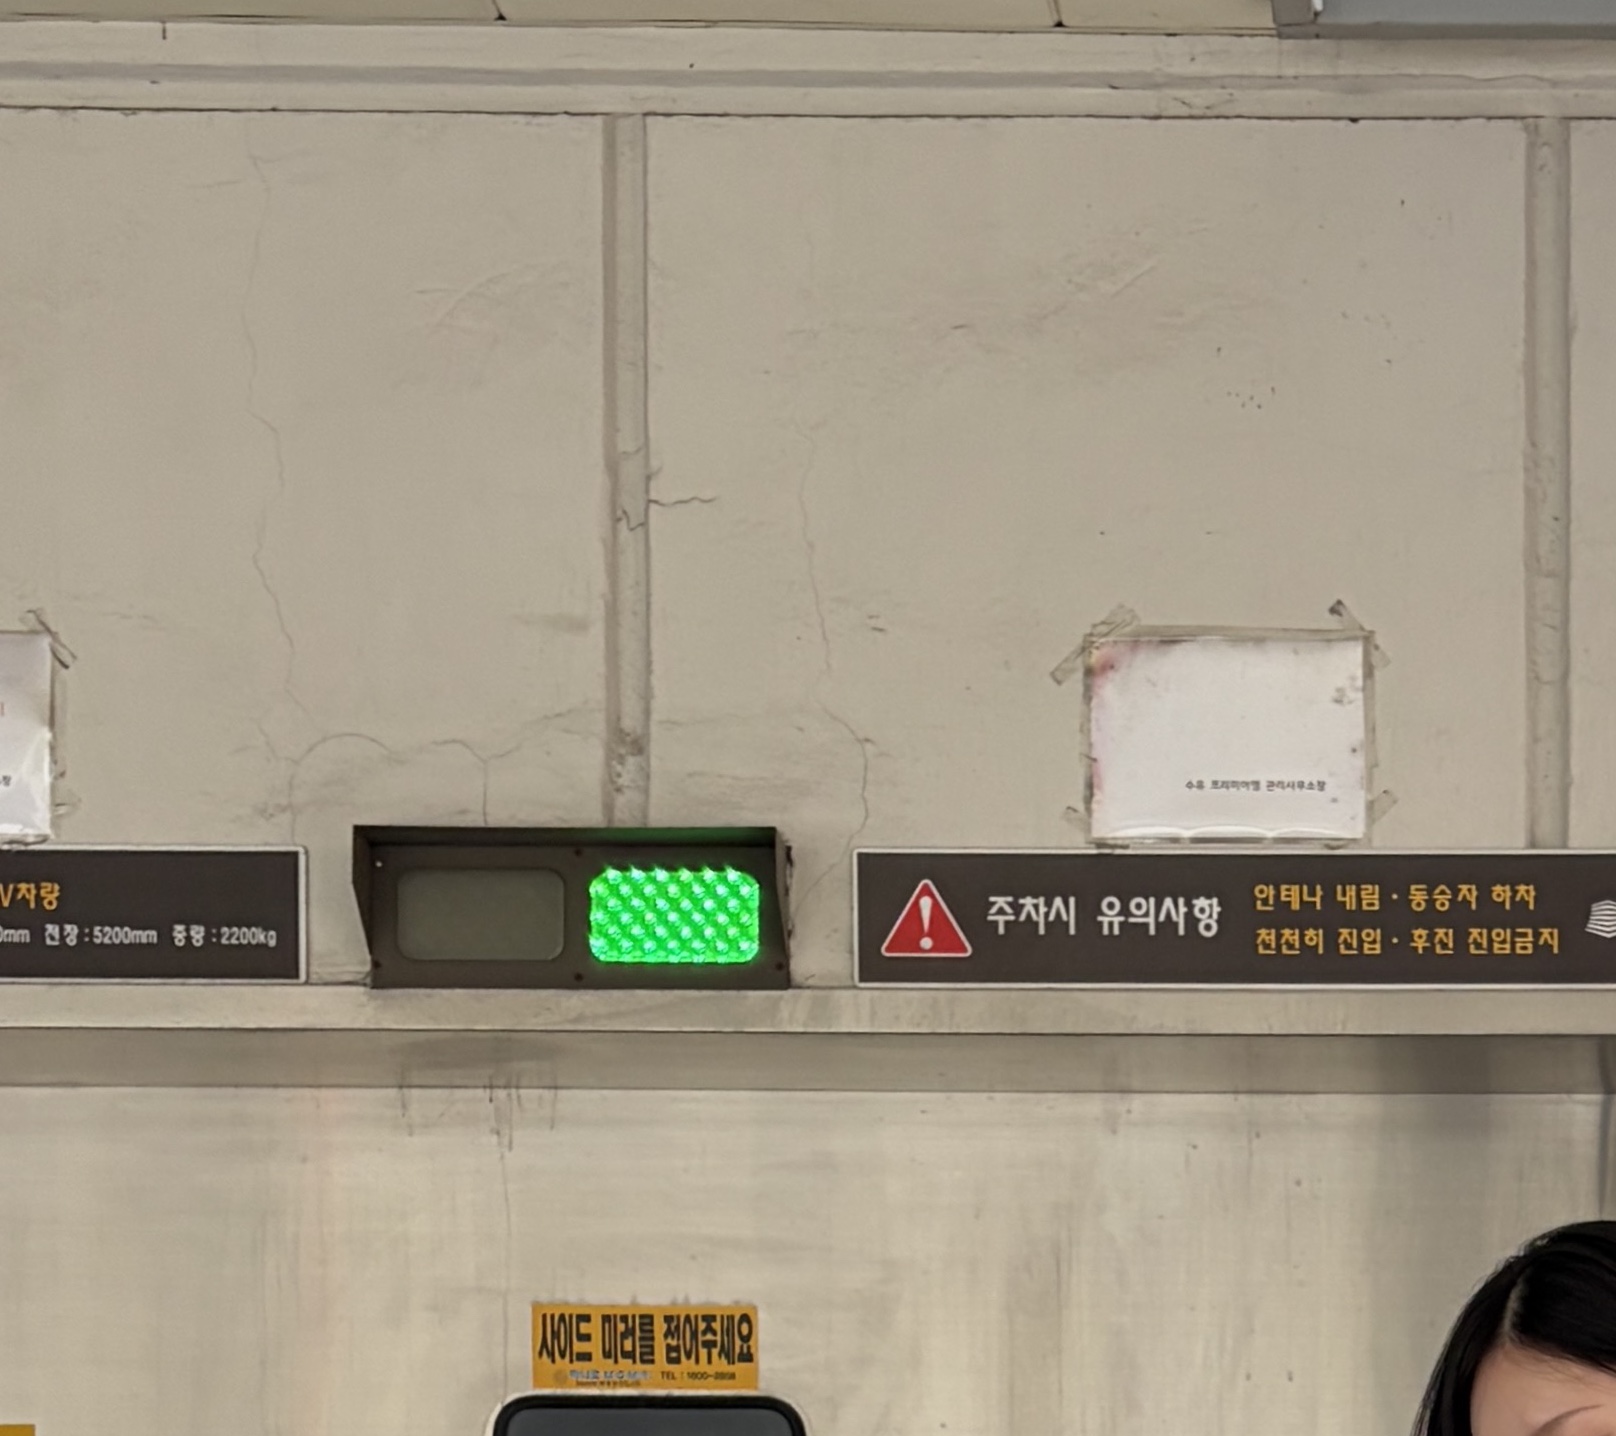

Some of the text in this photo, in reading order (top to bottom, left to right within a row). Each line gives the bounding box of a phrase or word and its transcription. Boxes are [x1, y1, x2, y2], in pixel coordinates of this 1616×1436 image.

[1254, 884, 1536, 911] 안테나 내림 동승자 하차
[986, 896, 1221, 938] 주차시 유의사항
[1255, 928, 1560, 955] 천천히 진입 후진 진입금지
[538, 1313, 754, 1365] 사이드 미러를 접어주세요
